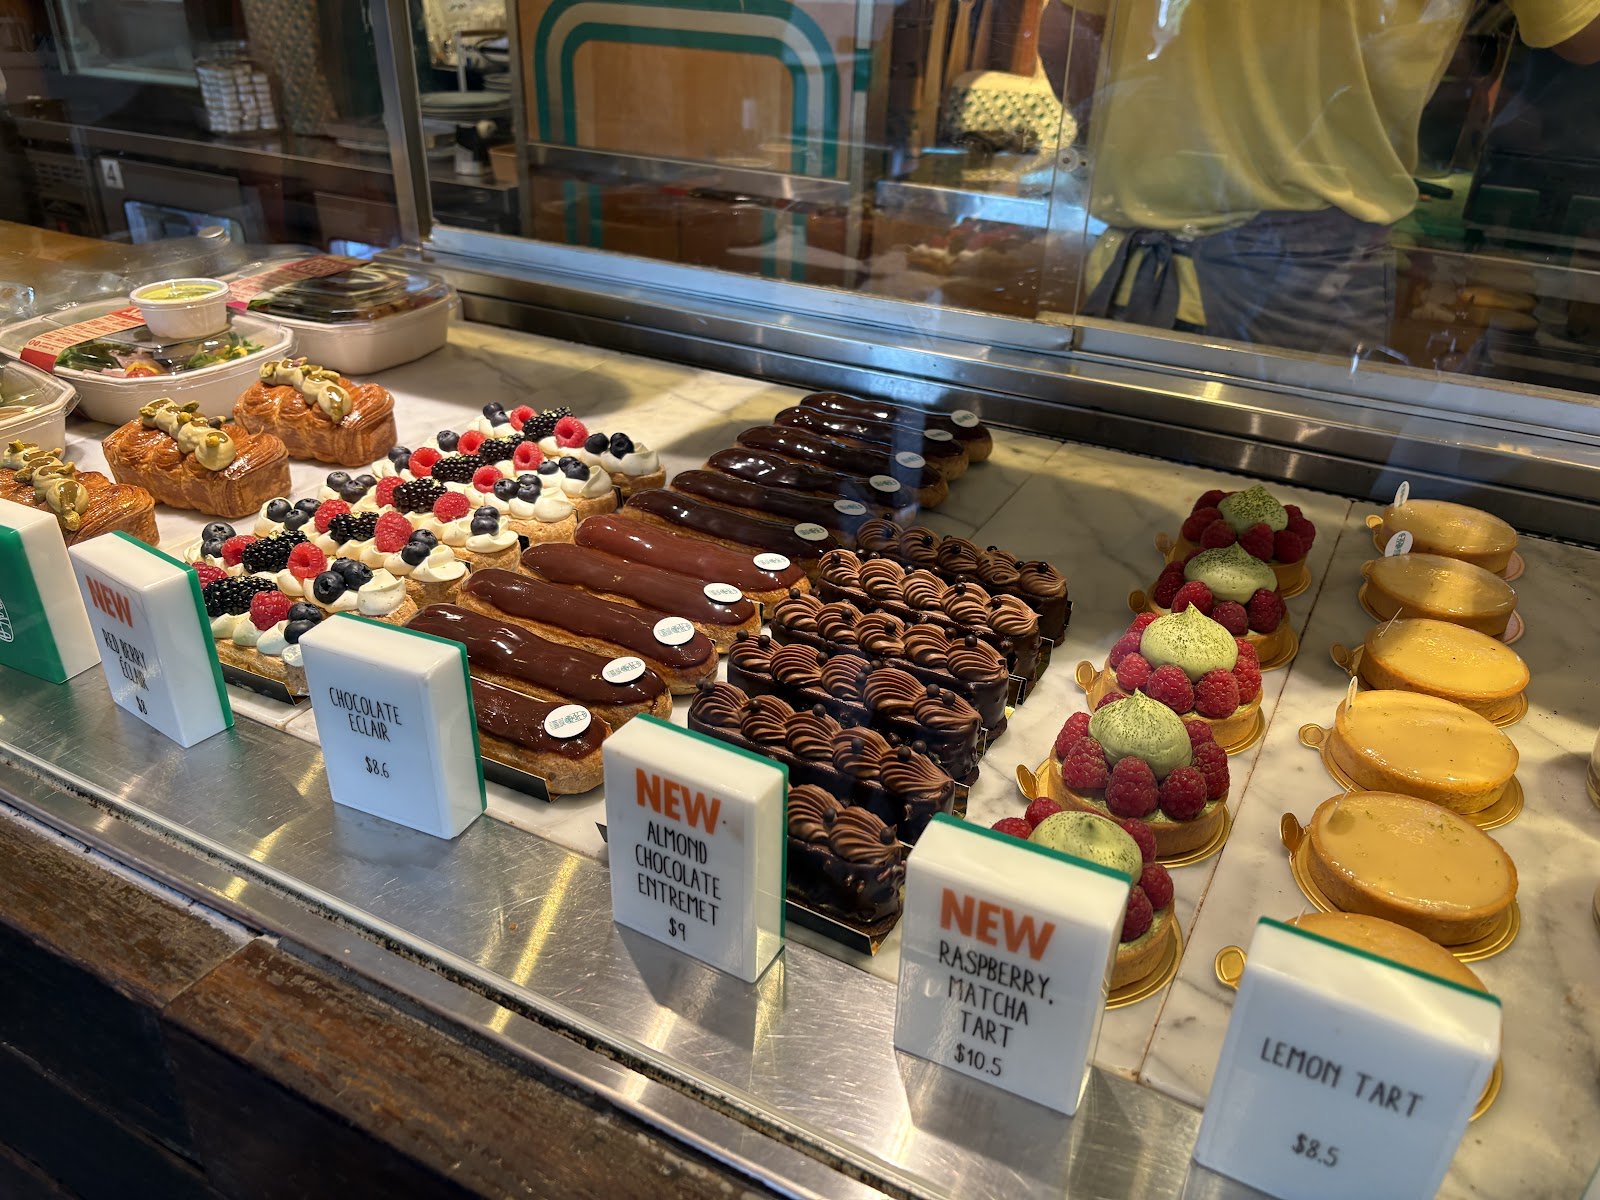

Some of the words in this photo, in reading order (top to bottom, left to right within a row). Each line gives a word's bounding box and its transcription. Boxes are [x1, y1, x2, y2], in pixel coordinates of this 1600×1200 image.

[85, 575, 133, 628] NEW
[102, 628, 120, 654] RED
[119, 639, 148, 671] BERRY
[329, 687, 402, 725] CHOCOLATE
[348, 714, 391, 742] ECLAIR
[365, 756, 390, 779] $8.6
[635, 768, 721, 835] NEW
[647, 820, 708, 865] ALMOND
[635, 844, 722, 900] CHOCOLATE
[638, 873, 719, 926] ENTREMET
[668, 918, 686, 941] $9
[940, 888, 1056, 961] NEW
[948, 975, 1029, 1025] MATCHA
[961, 1010, 1014, 1048] TART
[954, 1043, 1003, 1076] $10.5
[1260, 1037, 1343, 1088] LEMON
[1355, 1071, 1424, 1118] TART
[1291, 1132, 1340, 1168] $8.5
